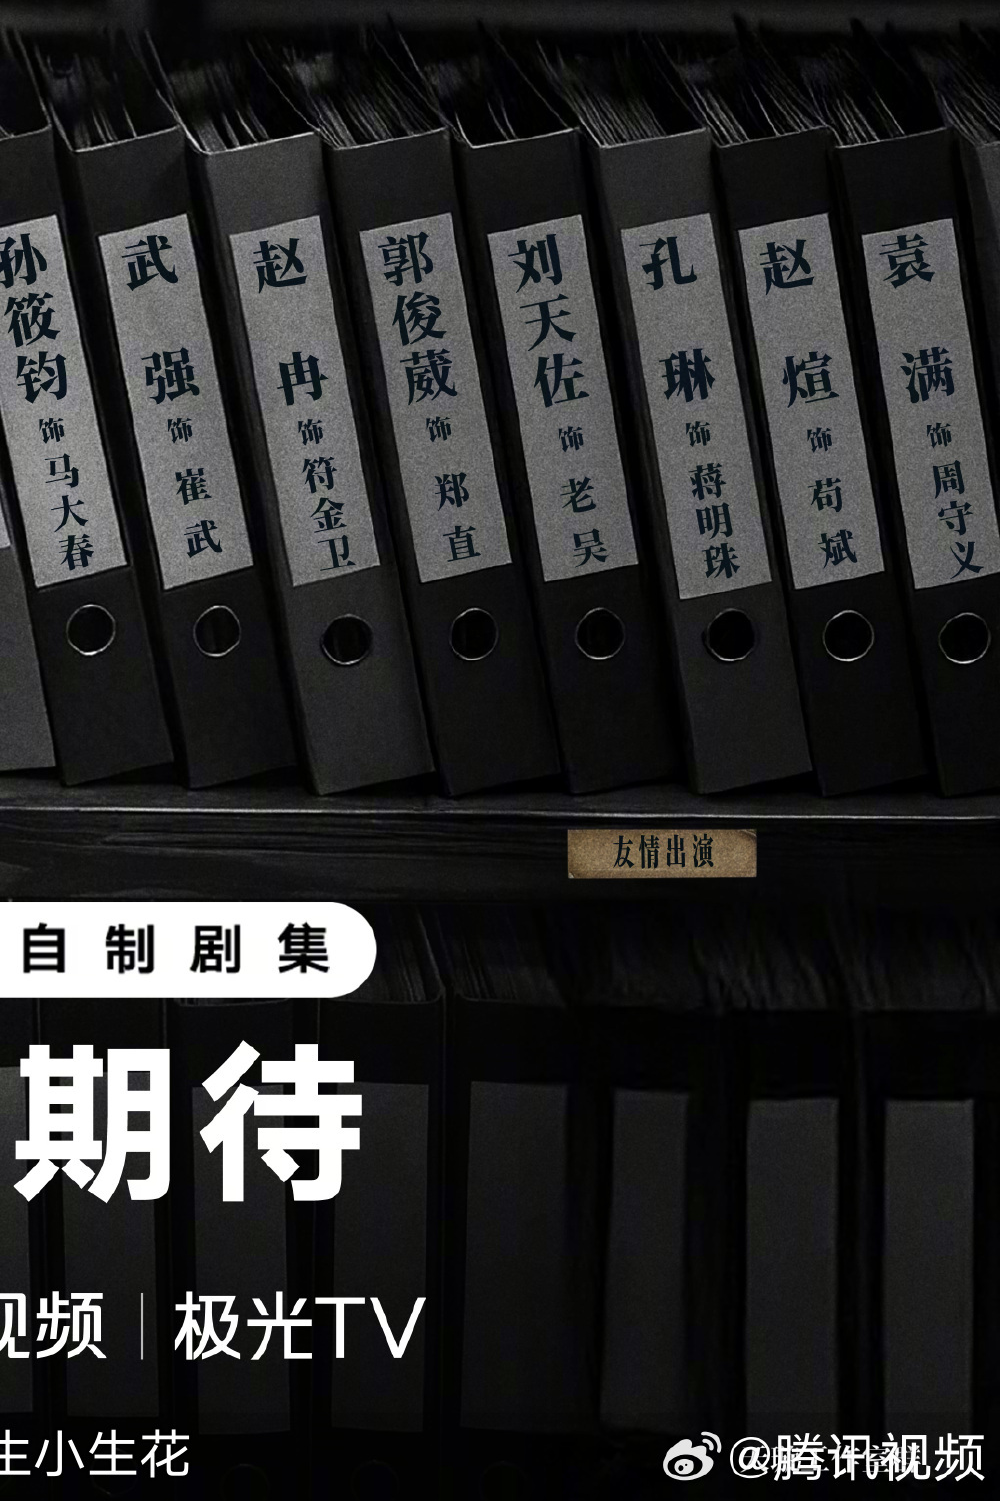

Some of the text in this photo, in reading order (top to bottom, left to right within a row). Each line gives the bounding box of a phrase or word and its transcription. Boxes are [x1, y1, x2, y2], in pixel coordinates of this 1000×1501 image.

[39, 418, 64, 443] 饰
[118, 233, 222, 558] 武强 饰 崔武
[250, 236, 359, 574] 赵冉 饰 符金卫
[375, 229, 481, 562] 郭俊葳 饰 郑直
[504, 231, 611, 570] 刘天佐 饰 老吴
[636, 234, 740, 578] 孔琳 饰 蒋明珠
[756, 236, 842, 411] 赵煊
[807, 428, 832, 452] 饰
[875, 231, 986, 582] 袁满 饰 周守义
[45, 454, 97, 573] 马大春
[613, 834, 714, 869] 友情出演
[174, 1290, 427, 1360] 极光TV
